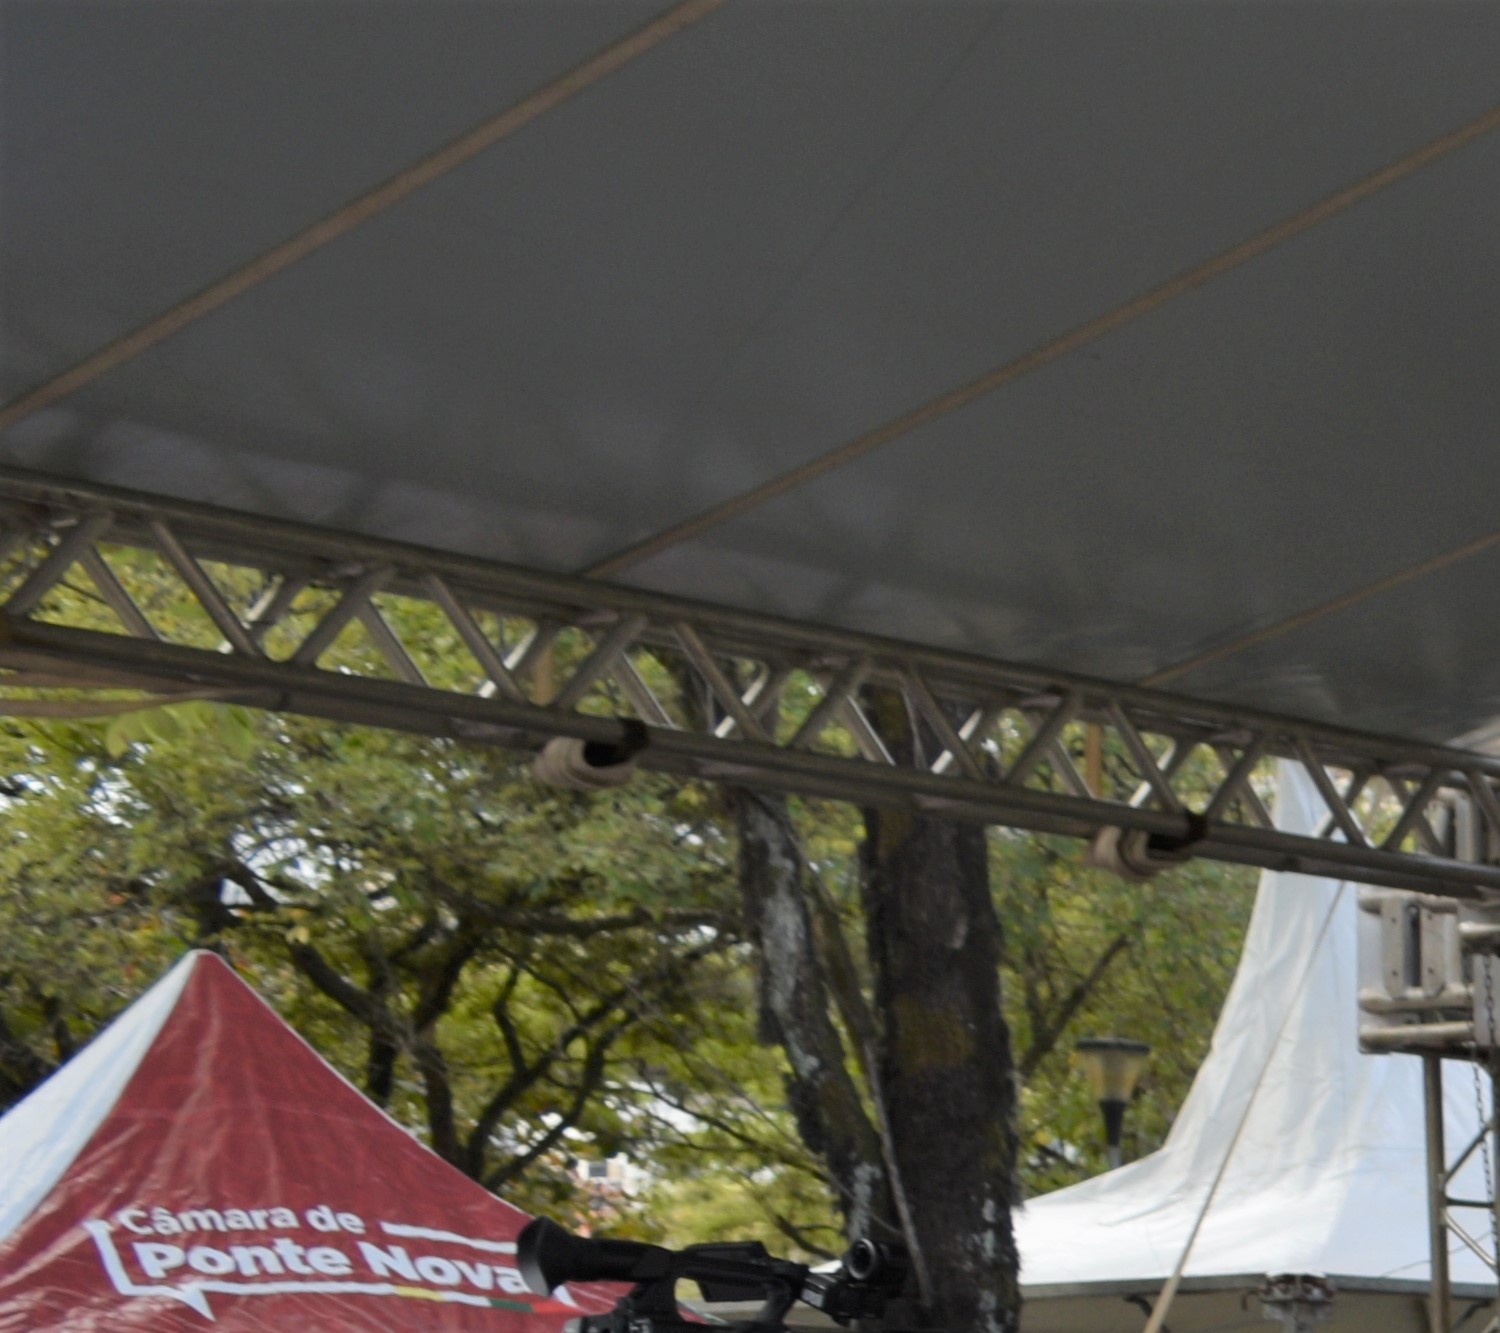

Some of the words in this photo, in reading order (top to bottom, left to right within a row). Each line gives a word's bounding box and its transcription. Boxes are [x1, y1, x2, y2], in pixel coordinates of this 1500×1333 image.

[119, 1207, 300, 1235] Câmara
[306, 1205, 364, 1234] de
[134, 1239, 353, 1279] Ponte
[359, 1242, 530, 1293] Nova
